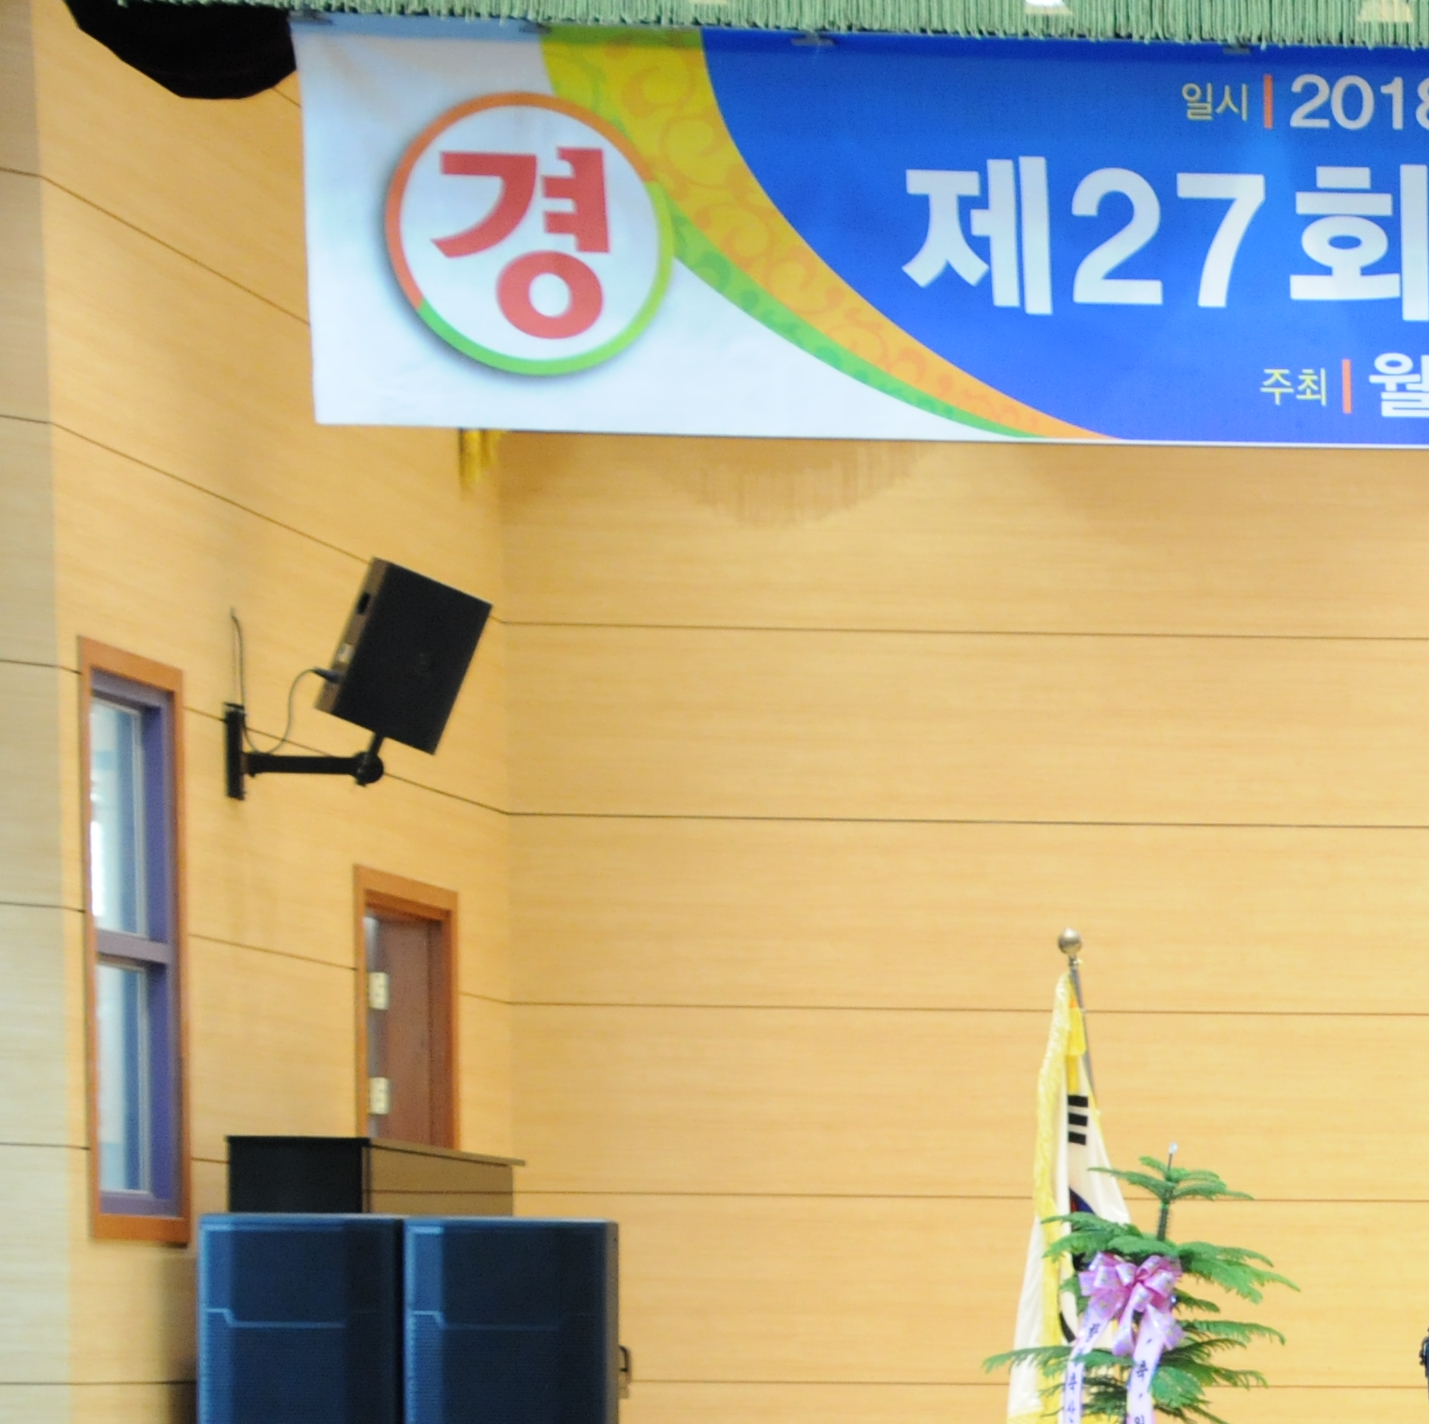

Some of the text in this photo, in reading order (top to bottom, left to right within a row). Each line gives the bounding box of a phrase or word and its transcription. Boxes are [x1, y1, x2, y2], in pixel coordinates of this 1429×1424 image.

[1182, 83, 1248, 120] 일시
[434, 145, 611, 340] 경
[1259, 366, 1329, 406] 주최
